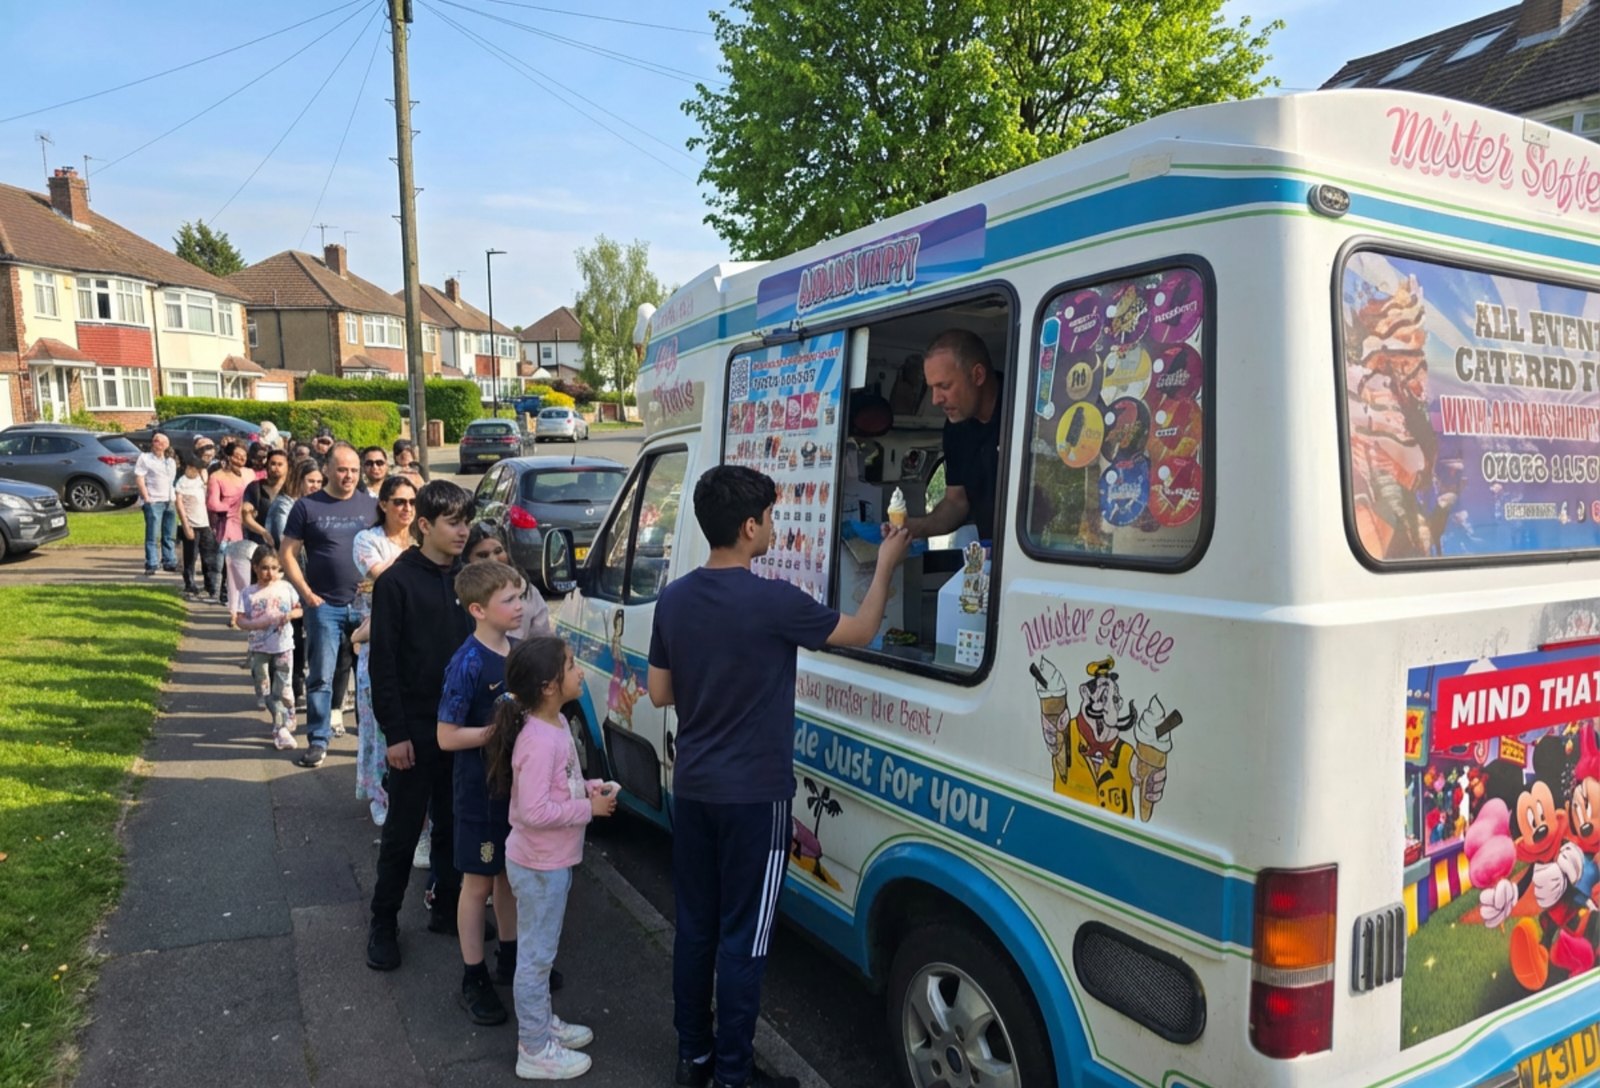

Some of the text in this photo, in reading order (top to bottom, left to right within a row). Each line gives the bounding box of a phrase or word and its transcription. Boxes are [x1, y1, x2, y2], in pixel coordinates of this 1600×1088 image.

[1387, 106, 1514, 188] Mister
[1475, 300, 1525, 343] ALL
[1455, 346, 1577, 391] CATERED
[1021, 603, 1175, 668] Mister Softee
[871, 692, 894, 723] the
[1451, 683, 1531, 730] MIND
[793, 722, 820, 759] de
[824, 735, 874, 786] Just
[930, 776, 989, 832] you
[1580, 1021, 1600, 1068] D
